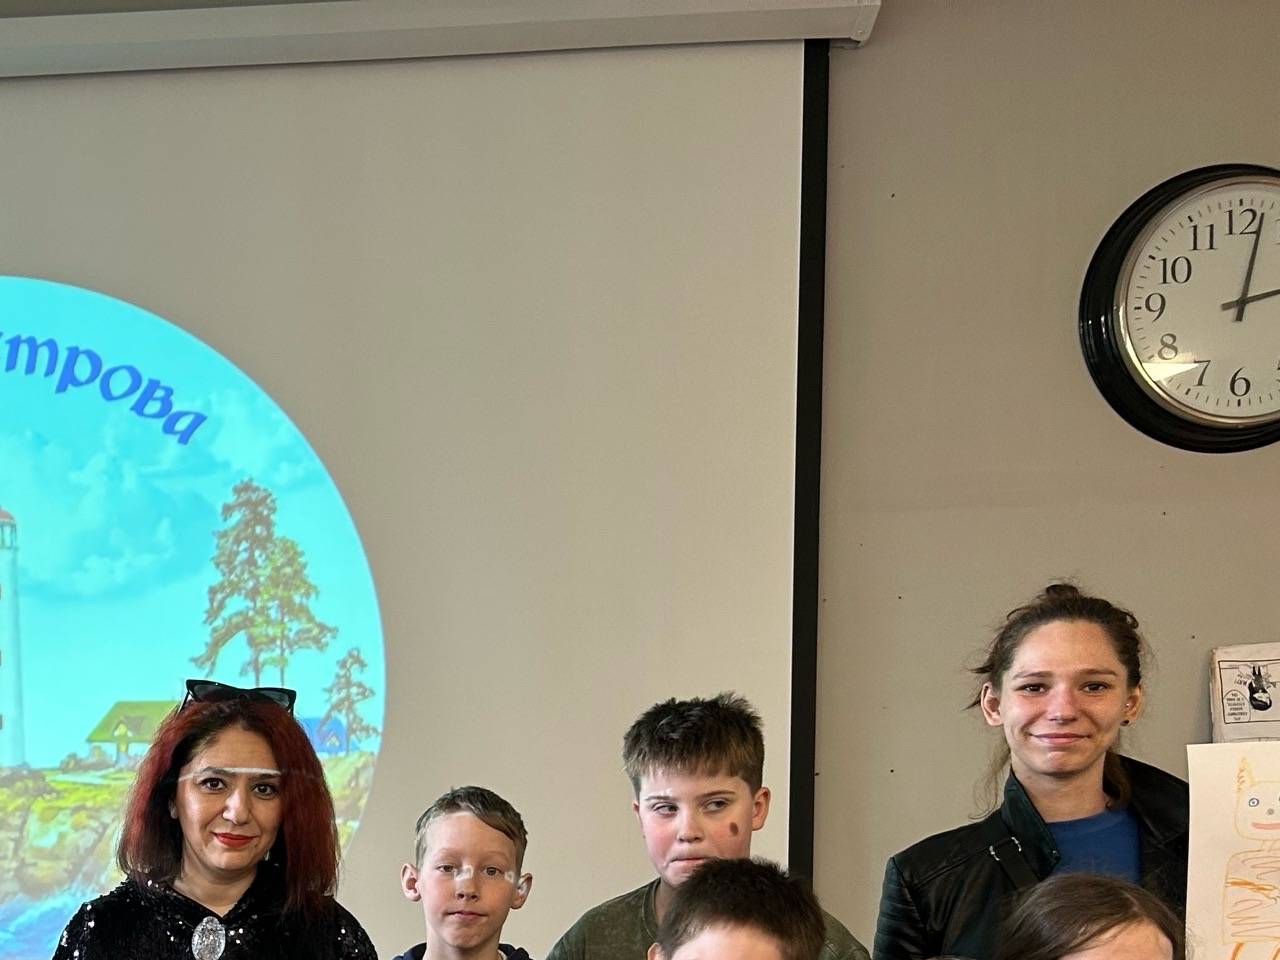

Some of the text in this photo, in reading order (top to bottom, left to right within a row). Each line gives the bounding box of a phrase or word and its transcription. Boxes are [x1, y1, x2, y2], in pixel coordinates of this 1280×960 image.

[1224, 208, 1258, 236] 12
[1188, 223, 1218, 251] 11
[1158, 256, 1192, 285] 10
[1144, 293, 1167, 322] 9
[1157, 333, 1178, 361] 8
[1193, 360, 1212, 387] 7
[1230, 367, 1251, 397] 6
